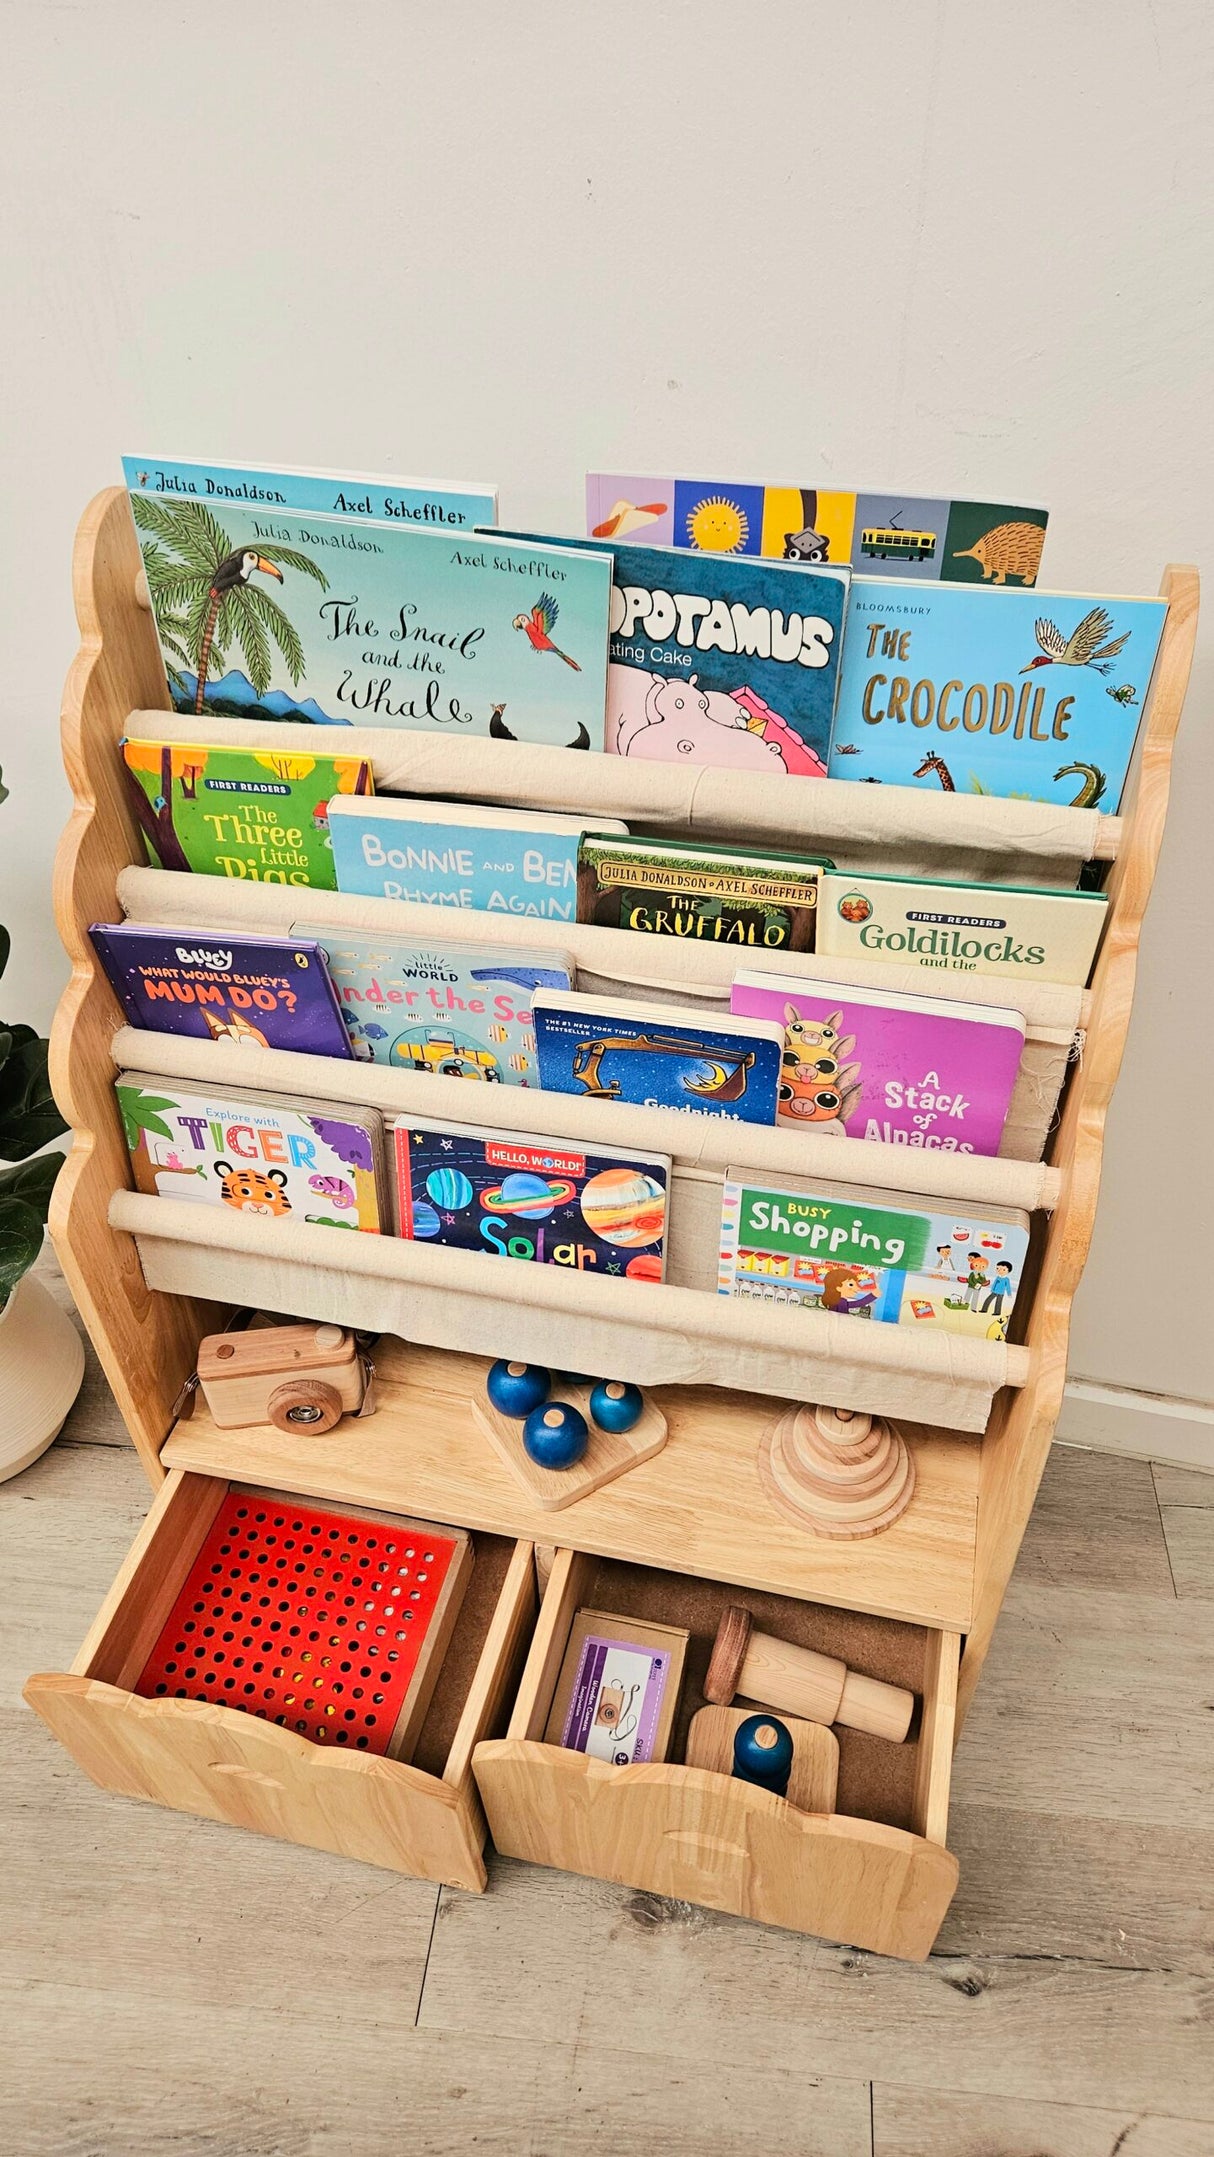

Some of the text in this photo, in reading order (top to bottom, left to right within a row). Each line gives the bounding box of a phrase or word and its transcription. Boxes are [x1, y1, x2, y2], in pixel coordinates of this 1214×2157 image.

[155, 471, 467, 524] Julia Donaldson Axel Scheffler
[251, 521, 567, 581] Julia Donaldson Axel Scheffler
[856, 602, 932, 615] BLOOMSBURY
[319, 594, 485, 659] The Snail
[866, 623, 912, 662] THE
[362, 649, 445, 674] and the
[650, 646, 692, 666] Cake
[336, 669, 473, 723] Whale
[862, 673, 1075, 741] CROCODILE
[209, 780, 287, 794] FIRST READERS
[238, 804, 277, 824] The
[203, 814, 303, 848] Three
[260, 847, 309, 867] Little
[361, 834, 474, 876] BONNIE
[482, 861, 515, 873] AND
[604, 866, 813, 901] JULIA DONALDSON AXEL SCHEFFLER
[667, 895, 700, 911] THE
[629, 907, 786, 946] GRUFFALO
[911, 913, 1001, 928] FIRST READERS
[859, 924, 1046, 965] Goldilocks
[402, 968, 459, 982] WORLD
[415, 961, 443, 971] little
[919, 957, 977, 971] and the
[138, 965, 291, 988] WHAT WOULD BLUEY'S
[143, 979, 298, 1013] MUM DO?
[426, 986, 486, 1014] the
[545, 1026, 591, 1036] BESTSELLER
[592, 1025, 613, 1033] YORK
[614, 1028, 637, 1036] TIMES
[917, 1071, 940, 1090] A
[884, 1081, 971, 1119] Stack
[205, 1107, 280, 1128] Explore with
[912, 1113, 938, 1130] of
[176, 1116, 318, 1170] TIGER
[491, 1150, 530, 1165] HELLO,
[787, 1202, 832, 1220] BUSY
[749, 1201, 906, 1265] Shopping
[575, 1685, 587, 1717] Imagination
[581, 1680, 599, 1732] Wooden Camera
[633, 1738, 644, 1760] SKU:
